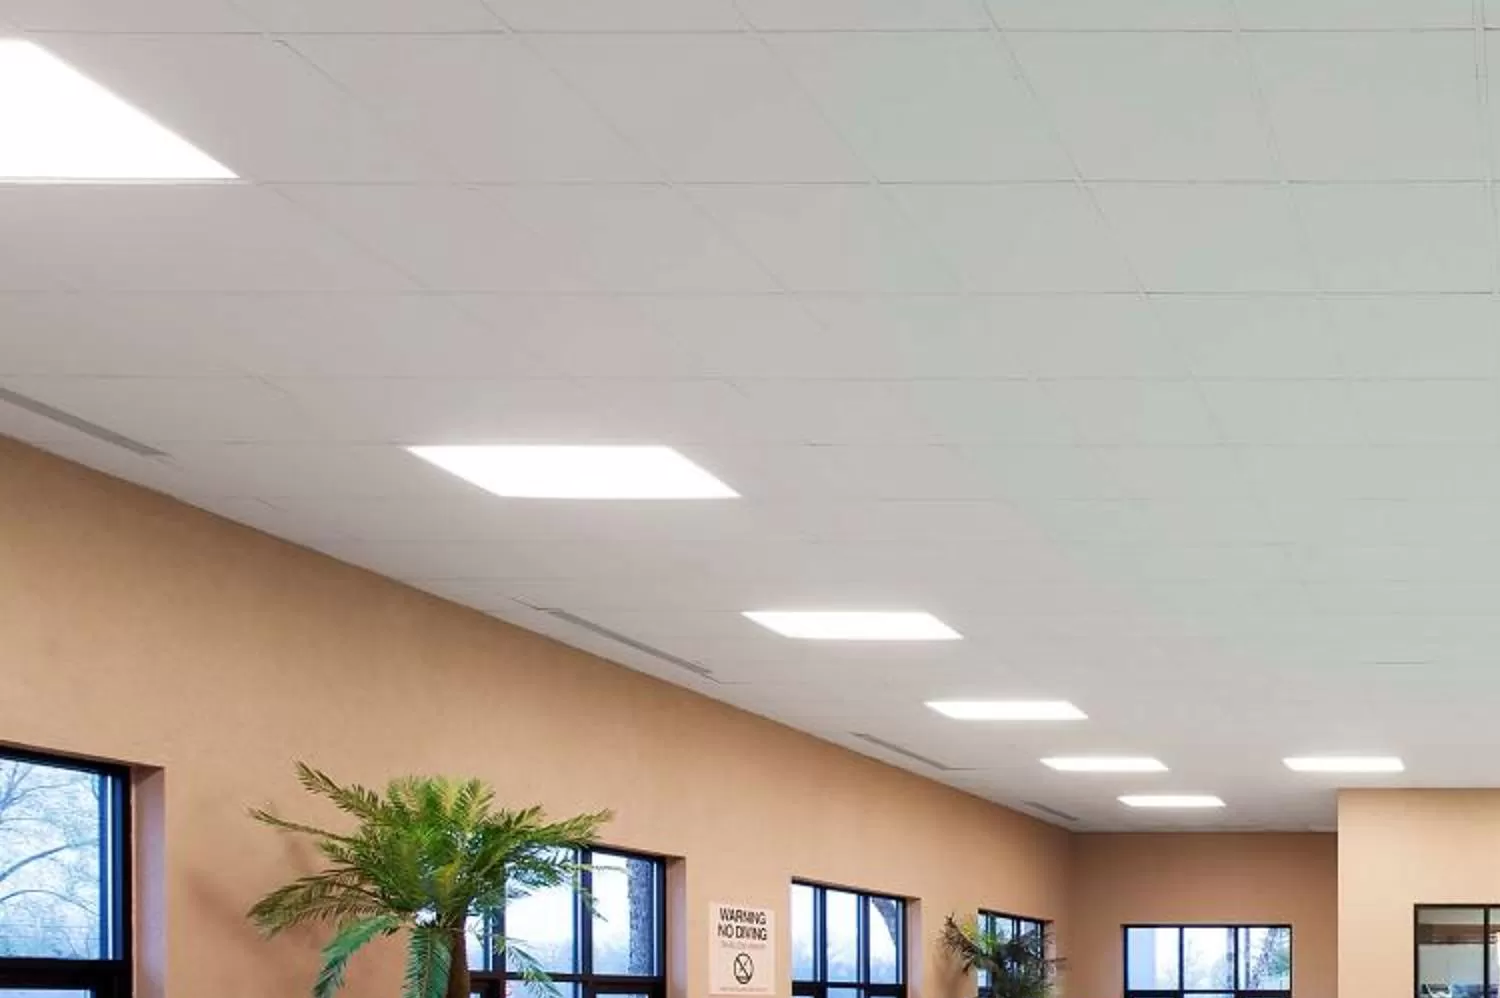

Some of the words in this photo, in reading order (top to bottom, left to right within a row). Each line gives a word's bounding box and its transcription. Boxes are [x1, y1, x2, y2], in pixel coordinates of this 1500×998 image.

[720, 907, 767, 925] WARNING
[717, 922, 734, 939] NO
[736, 925, 767, 941] DIVING
